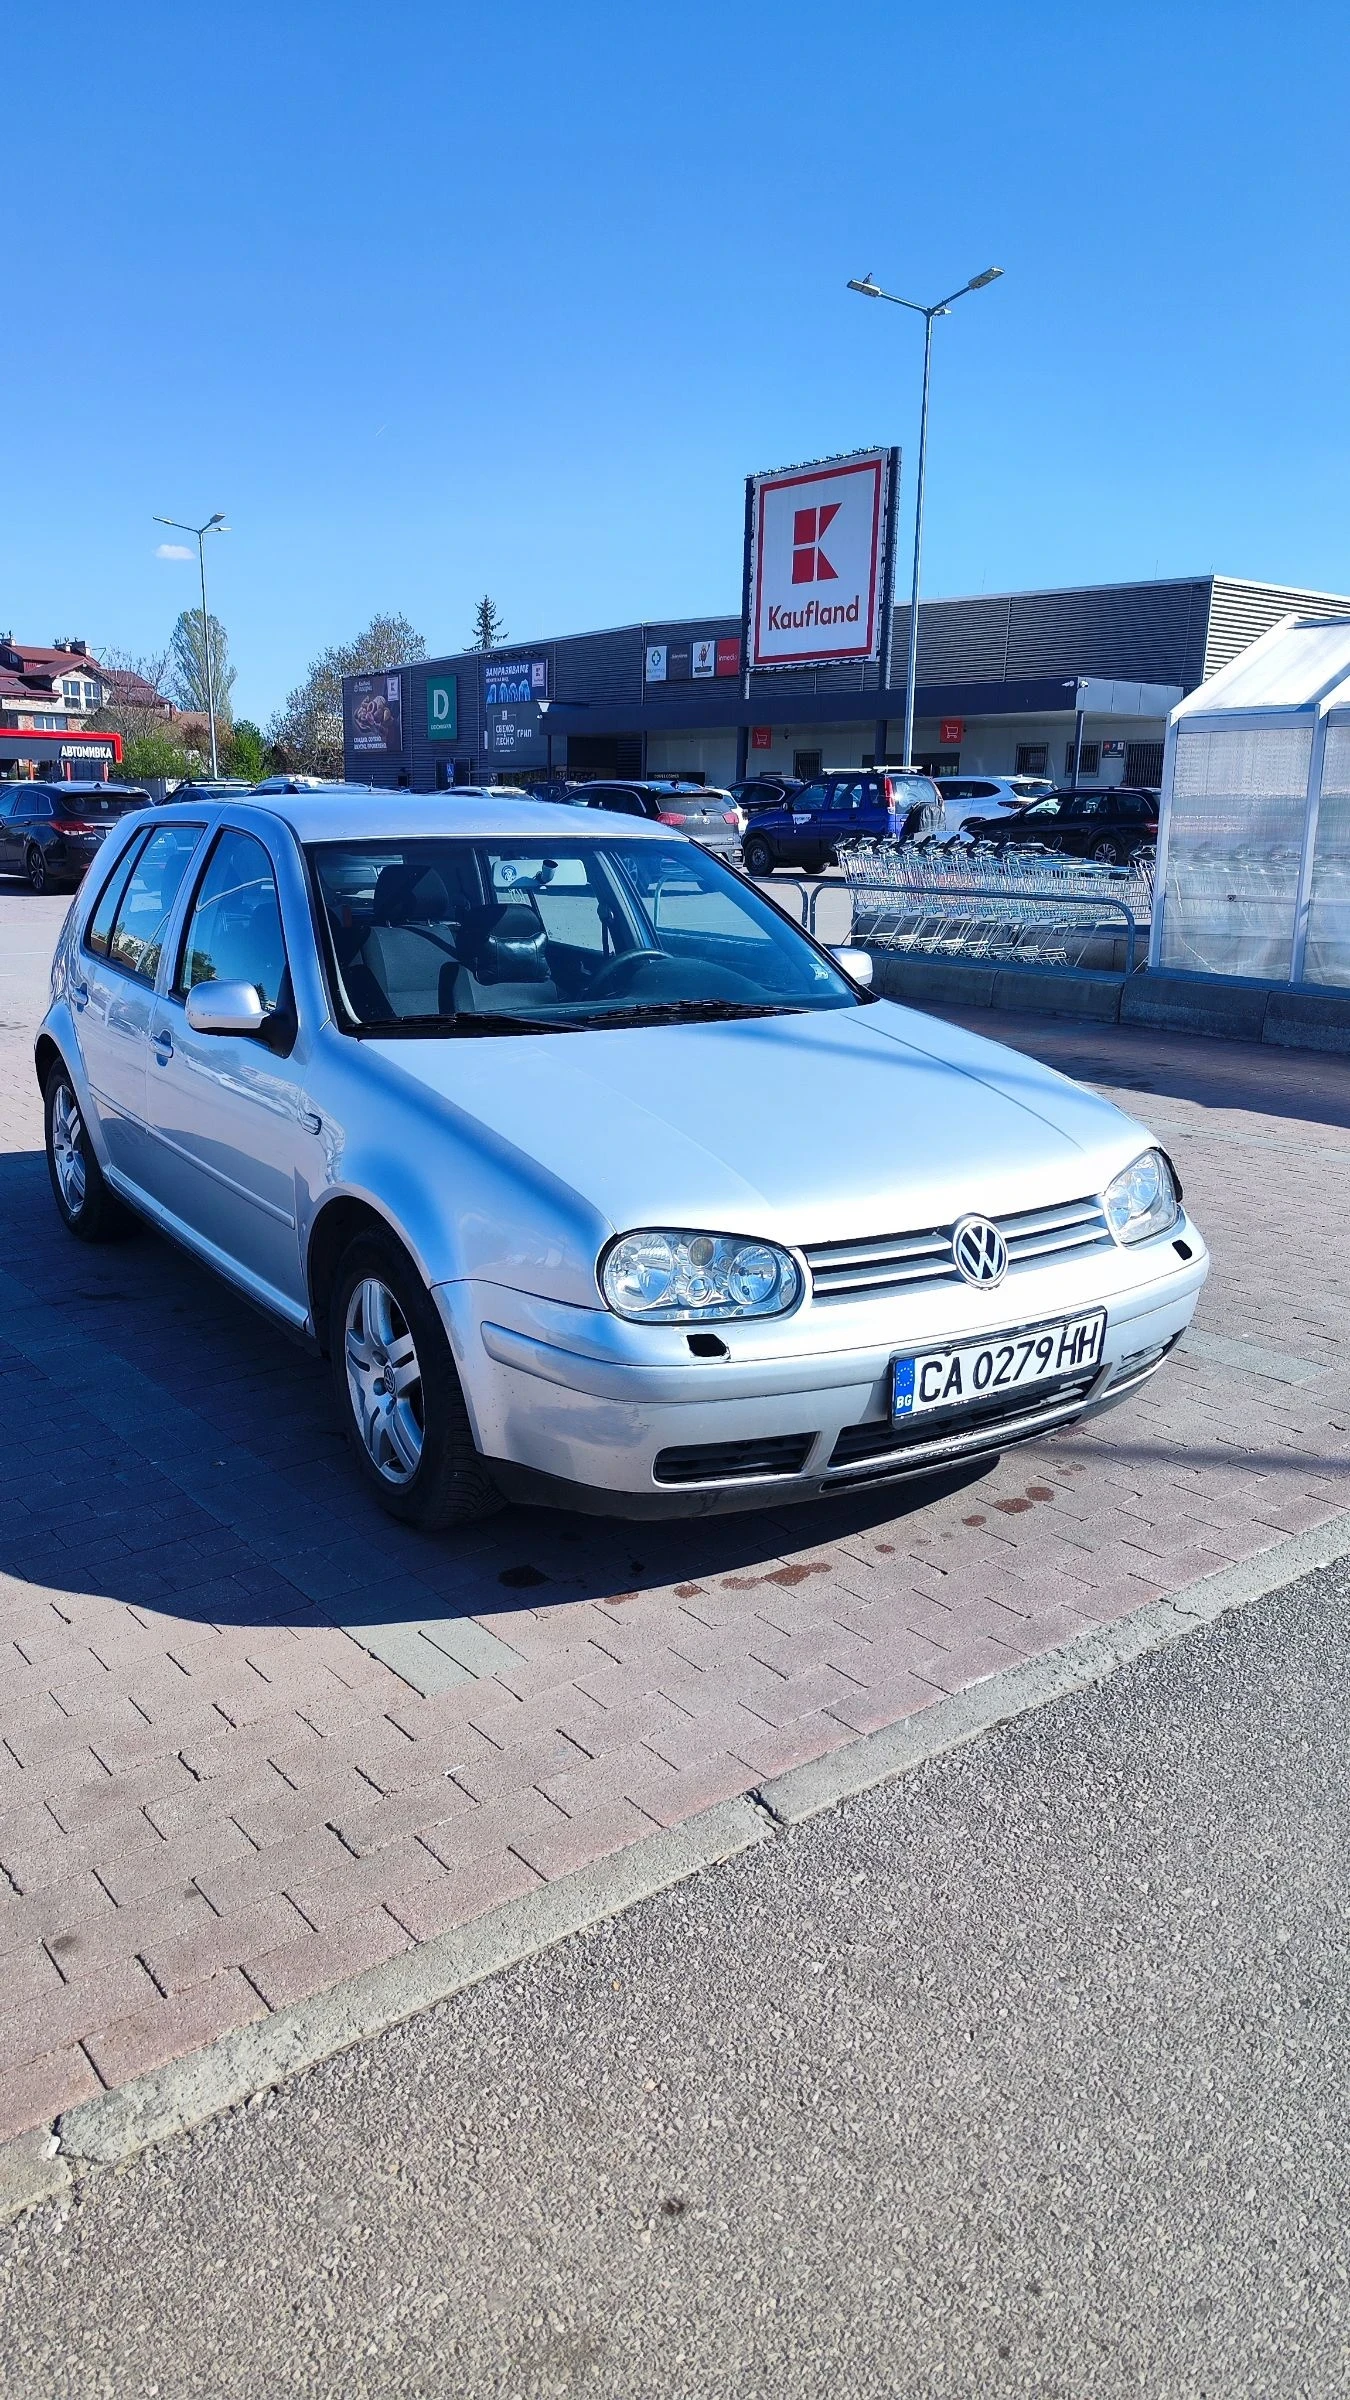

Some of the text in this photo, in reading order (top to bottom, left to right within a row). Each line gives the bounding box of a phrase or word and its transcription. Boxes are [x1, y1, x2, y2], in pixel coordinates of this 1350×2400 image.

[768, 595, 860, 631] Kaufland
[61, 745, 112, 758] АВТОМИВКА
[919, 1356, 963, 1403] CA
[896, 1394, 913, 1409] BG
